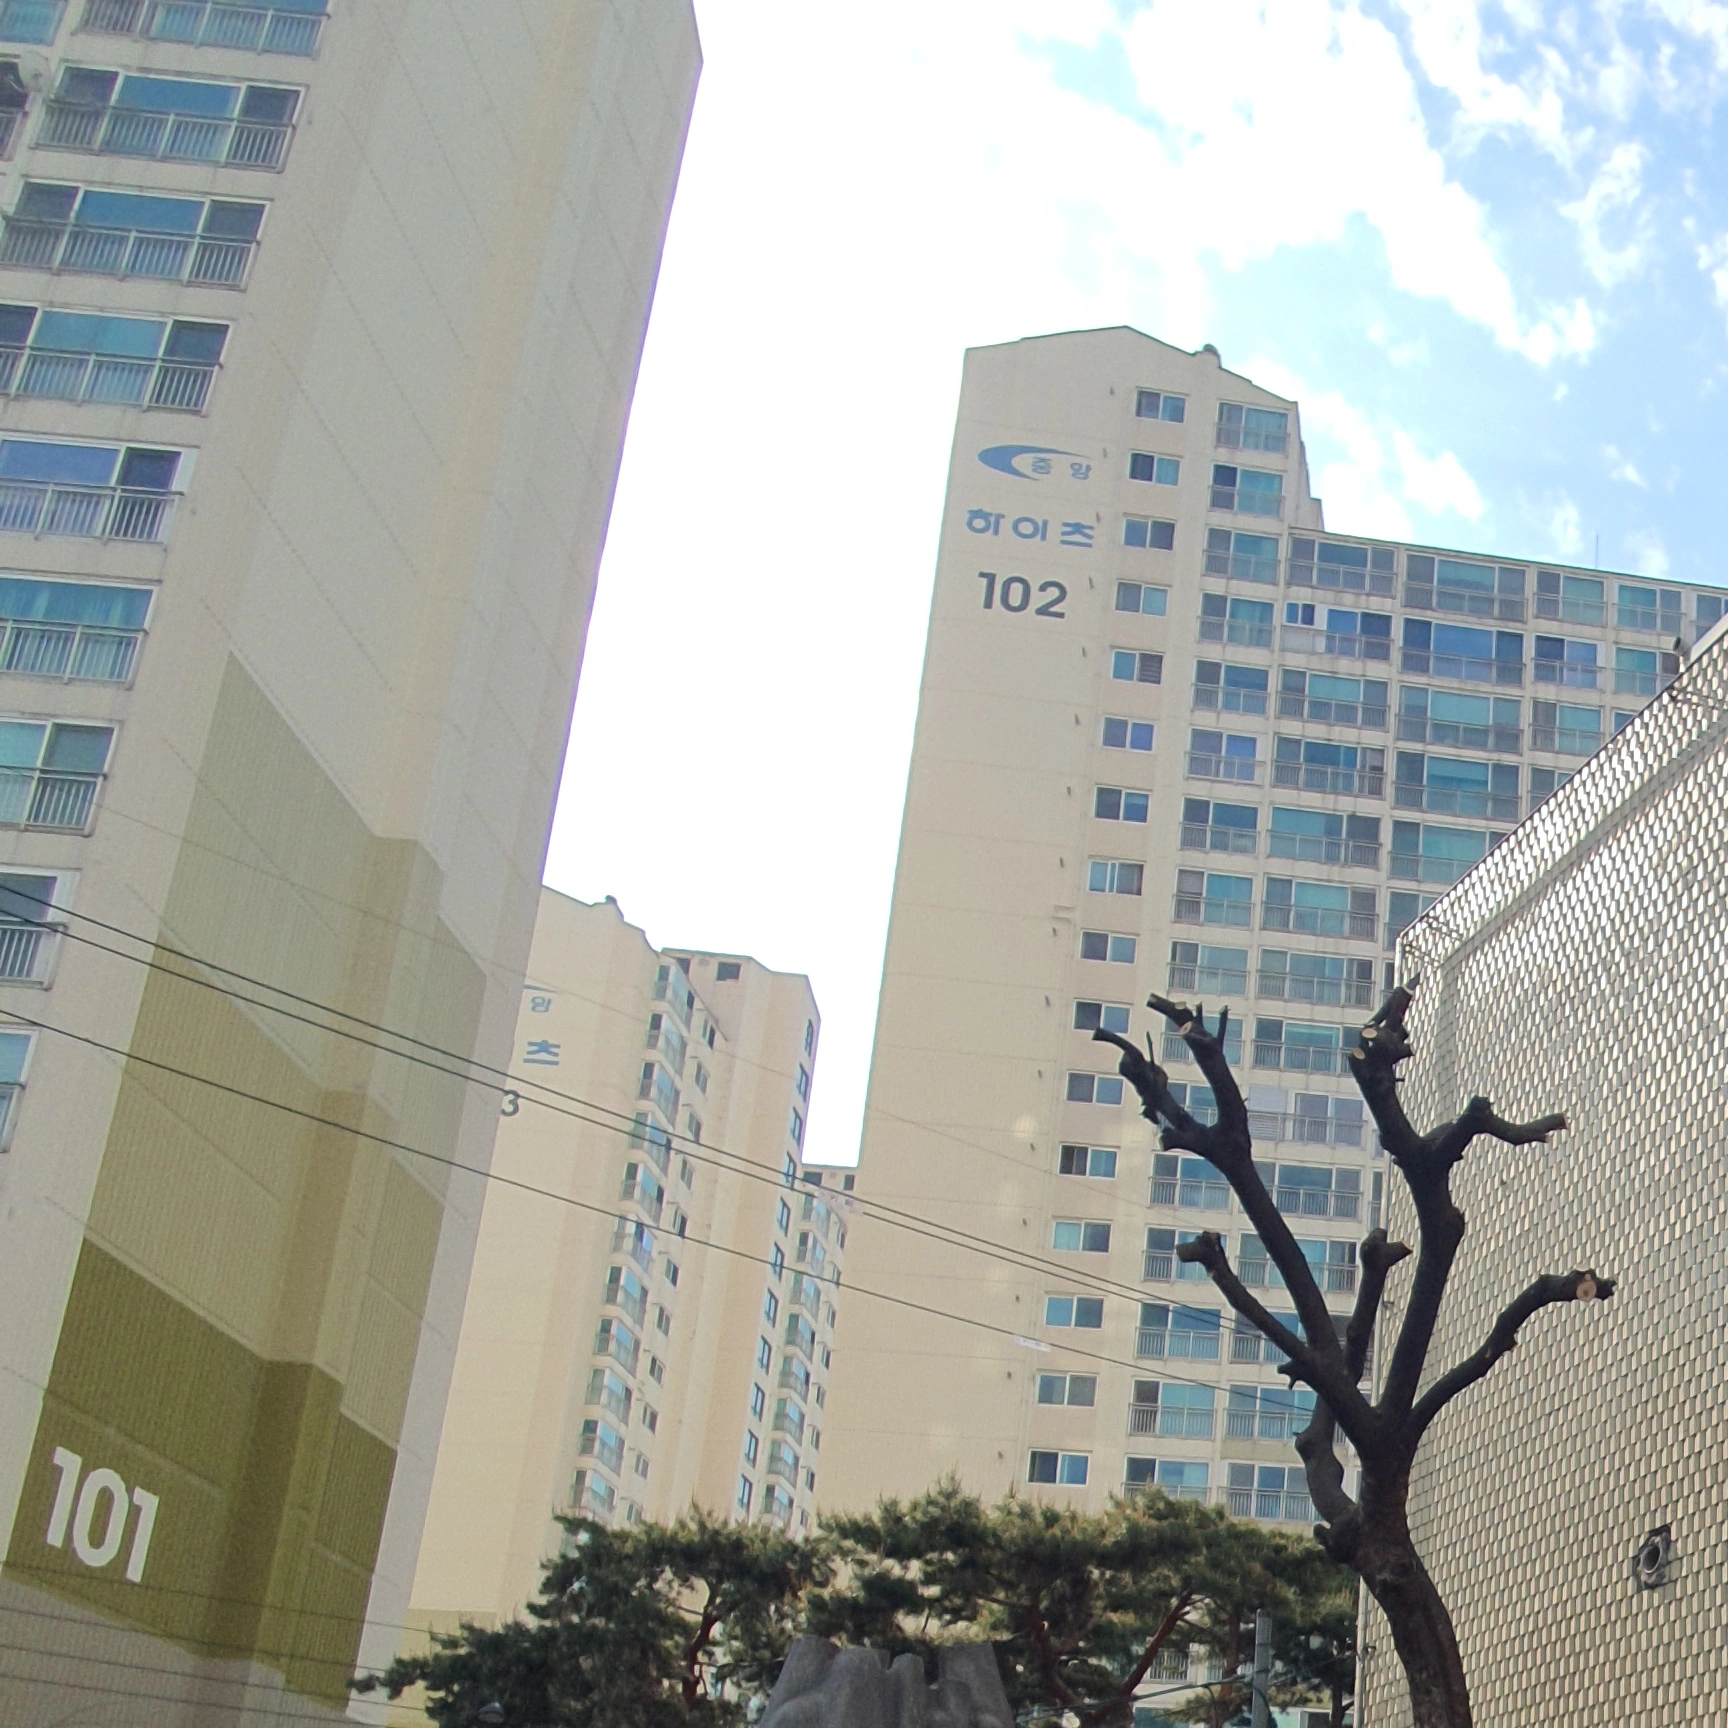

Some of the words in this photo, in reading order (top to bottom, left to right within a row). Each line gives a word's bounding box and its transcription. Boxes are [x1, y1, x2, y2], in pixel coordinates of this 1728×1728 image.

[966, 508, 1095, 548] 하이츠
[978, 570, 1068, 619] 102
[46, 1446, 159, 1583] 101
